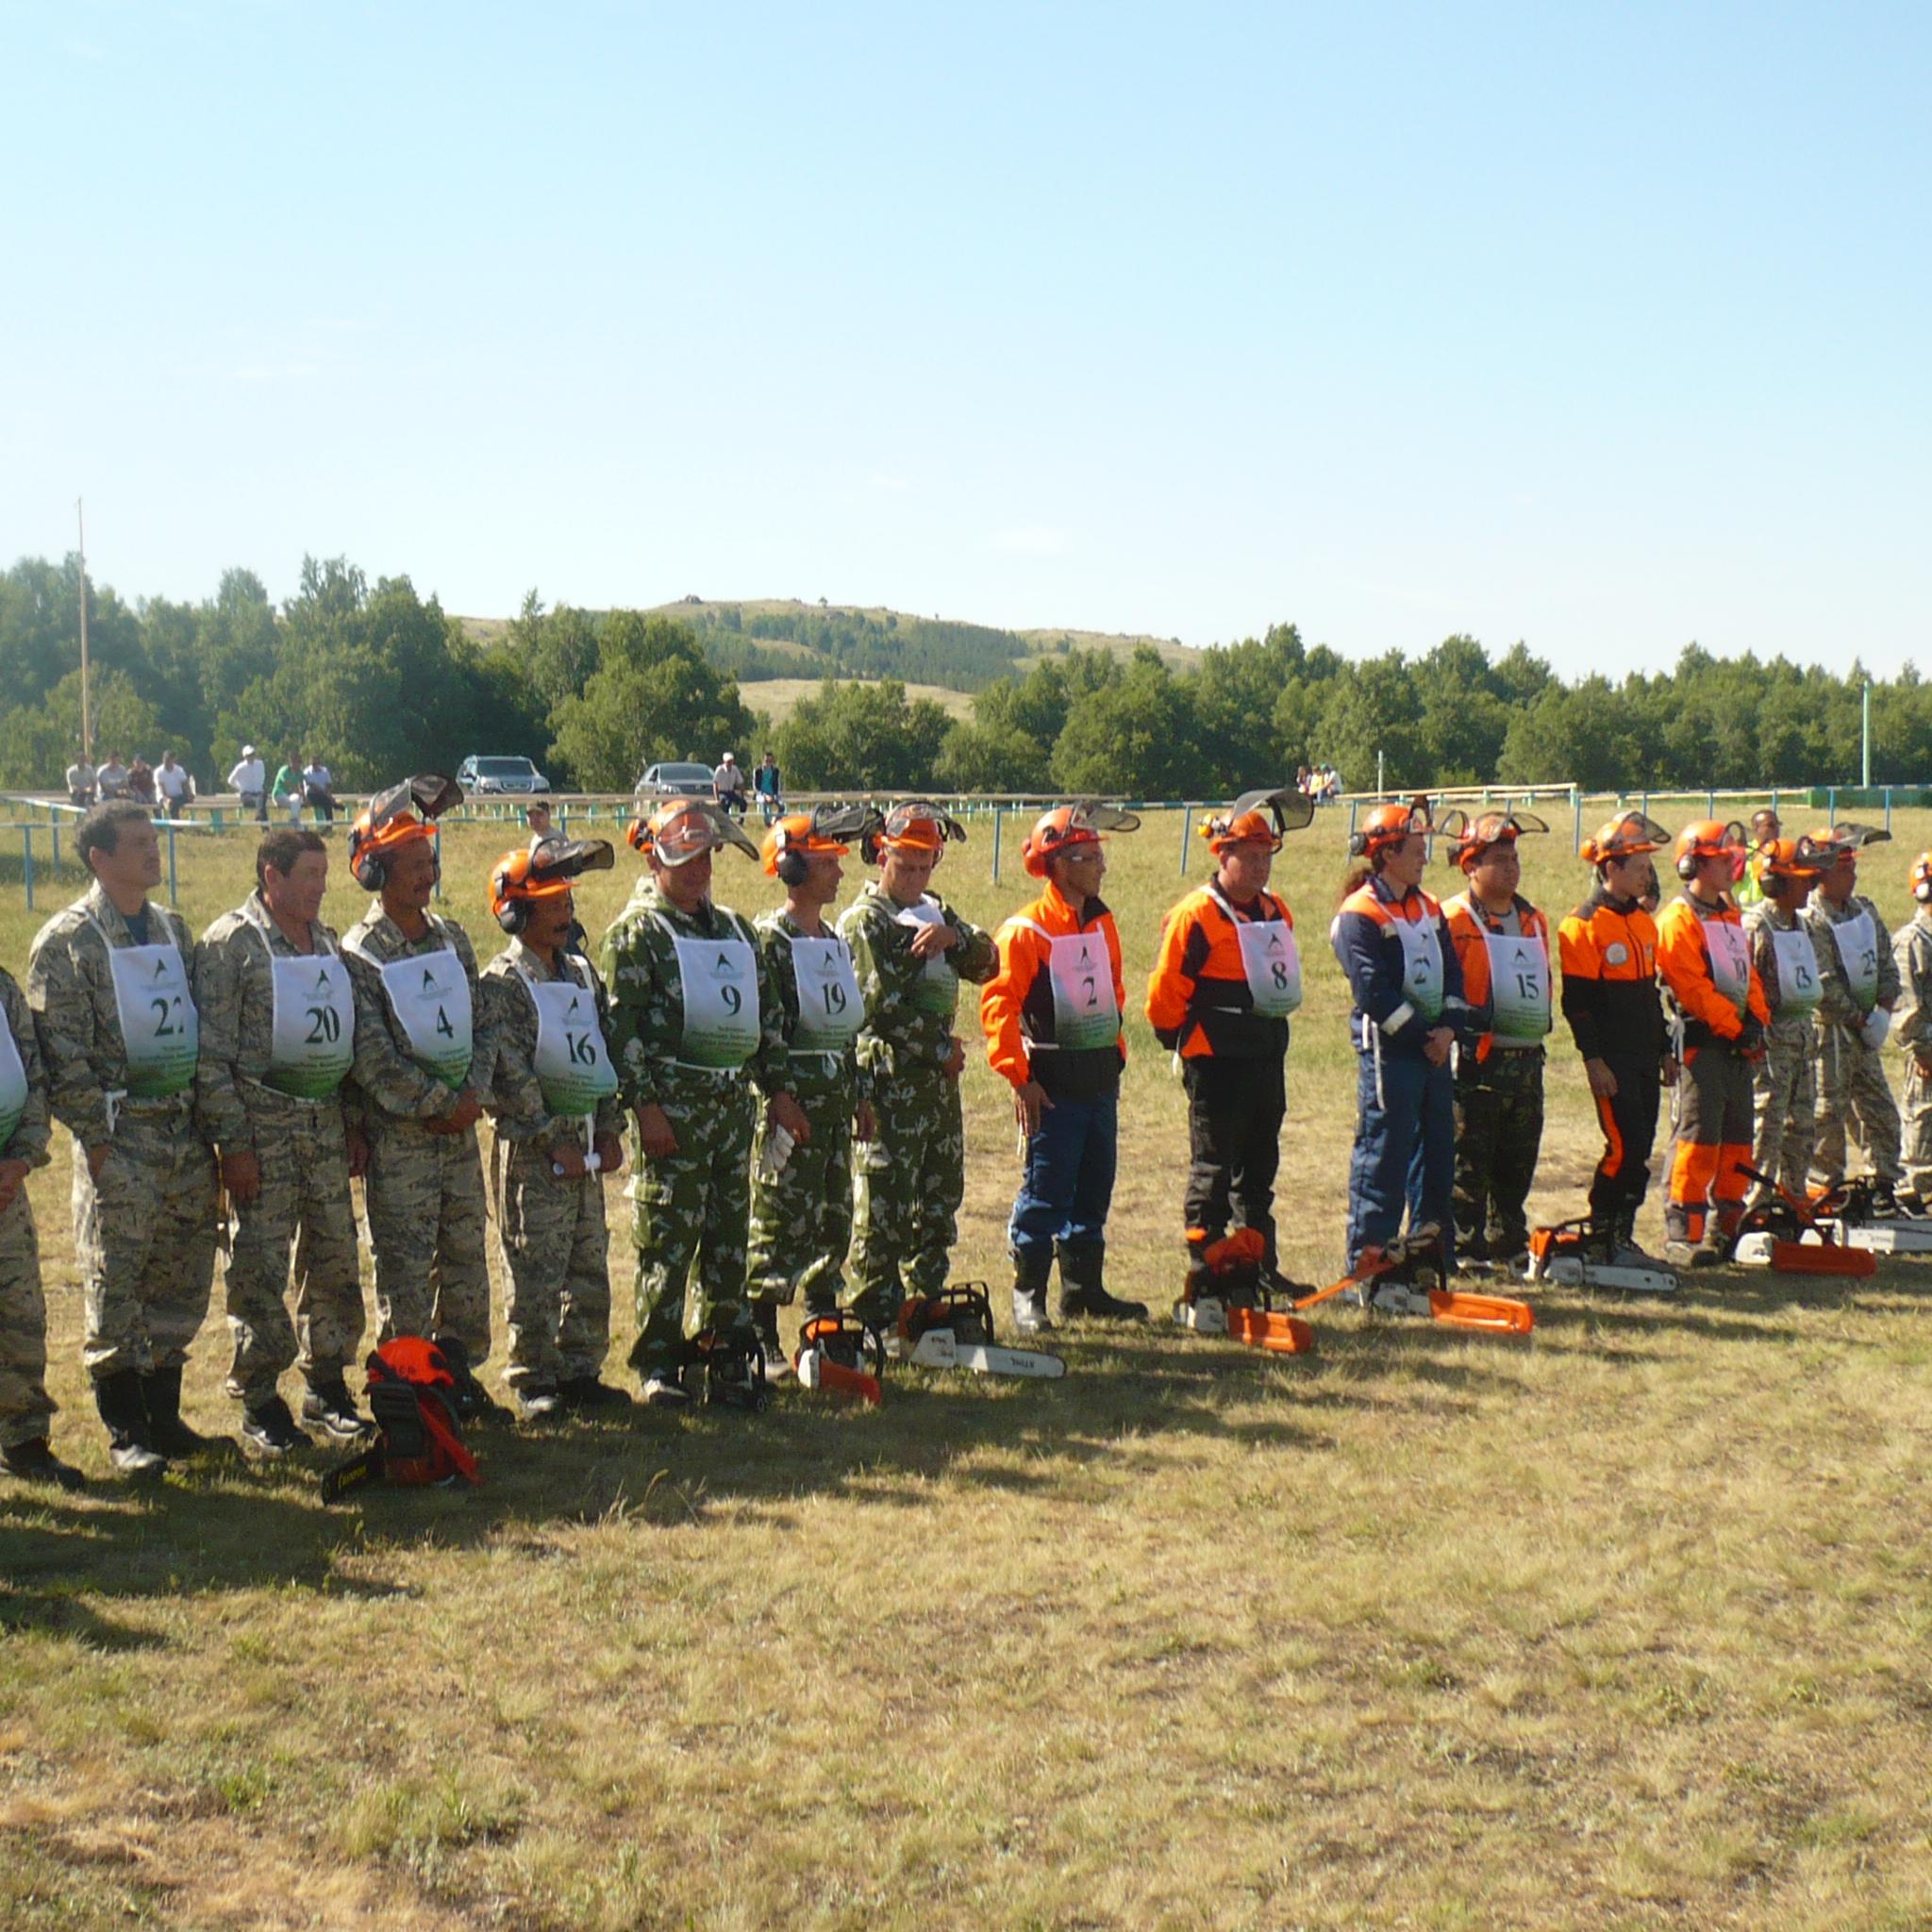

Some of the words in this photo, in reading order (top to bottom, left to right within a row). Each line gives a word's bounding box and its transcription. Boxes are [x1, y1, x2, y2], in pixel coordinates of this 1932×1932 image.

[1083, 975, 1098, 1006] 2
[1271, 961, 1288, 991] 8
[1517, 973, 1540, 1000] 15
[721, 985, 741, 1017] 9
[822, 983, 847, 1016] 19
[304, 1005, 341, 1044] 20
[436, 1005, 454, 1040] 4
[565, 1031, 597, 1066] 16
